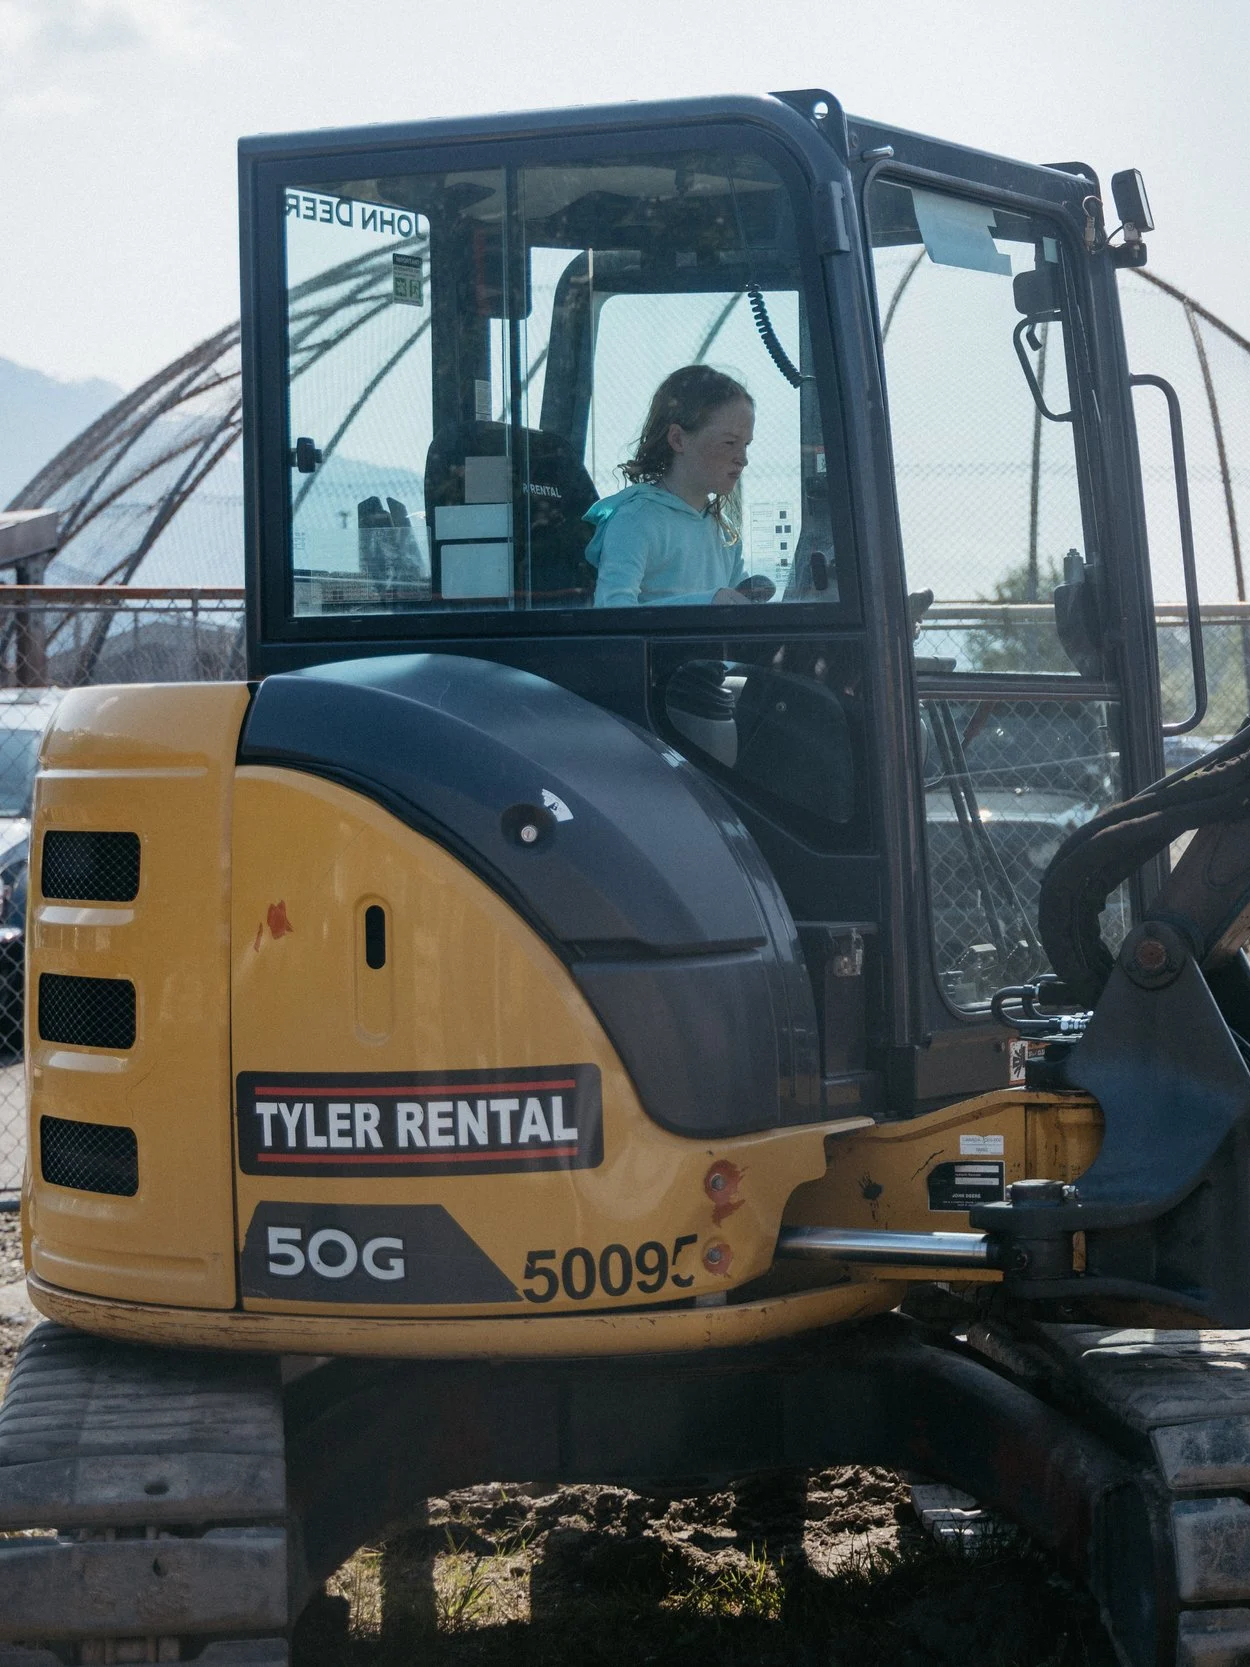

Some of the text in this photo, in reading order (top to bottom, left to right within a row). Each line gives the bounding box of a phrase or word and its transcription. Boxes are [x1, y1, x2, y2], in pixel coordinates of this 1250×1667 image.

[530, 484, 562, 498] RENTAL
[255, 1096, 579, 1148] TYLER RENTAL
[267, 1226, 406, 1281] 50G
